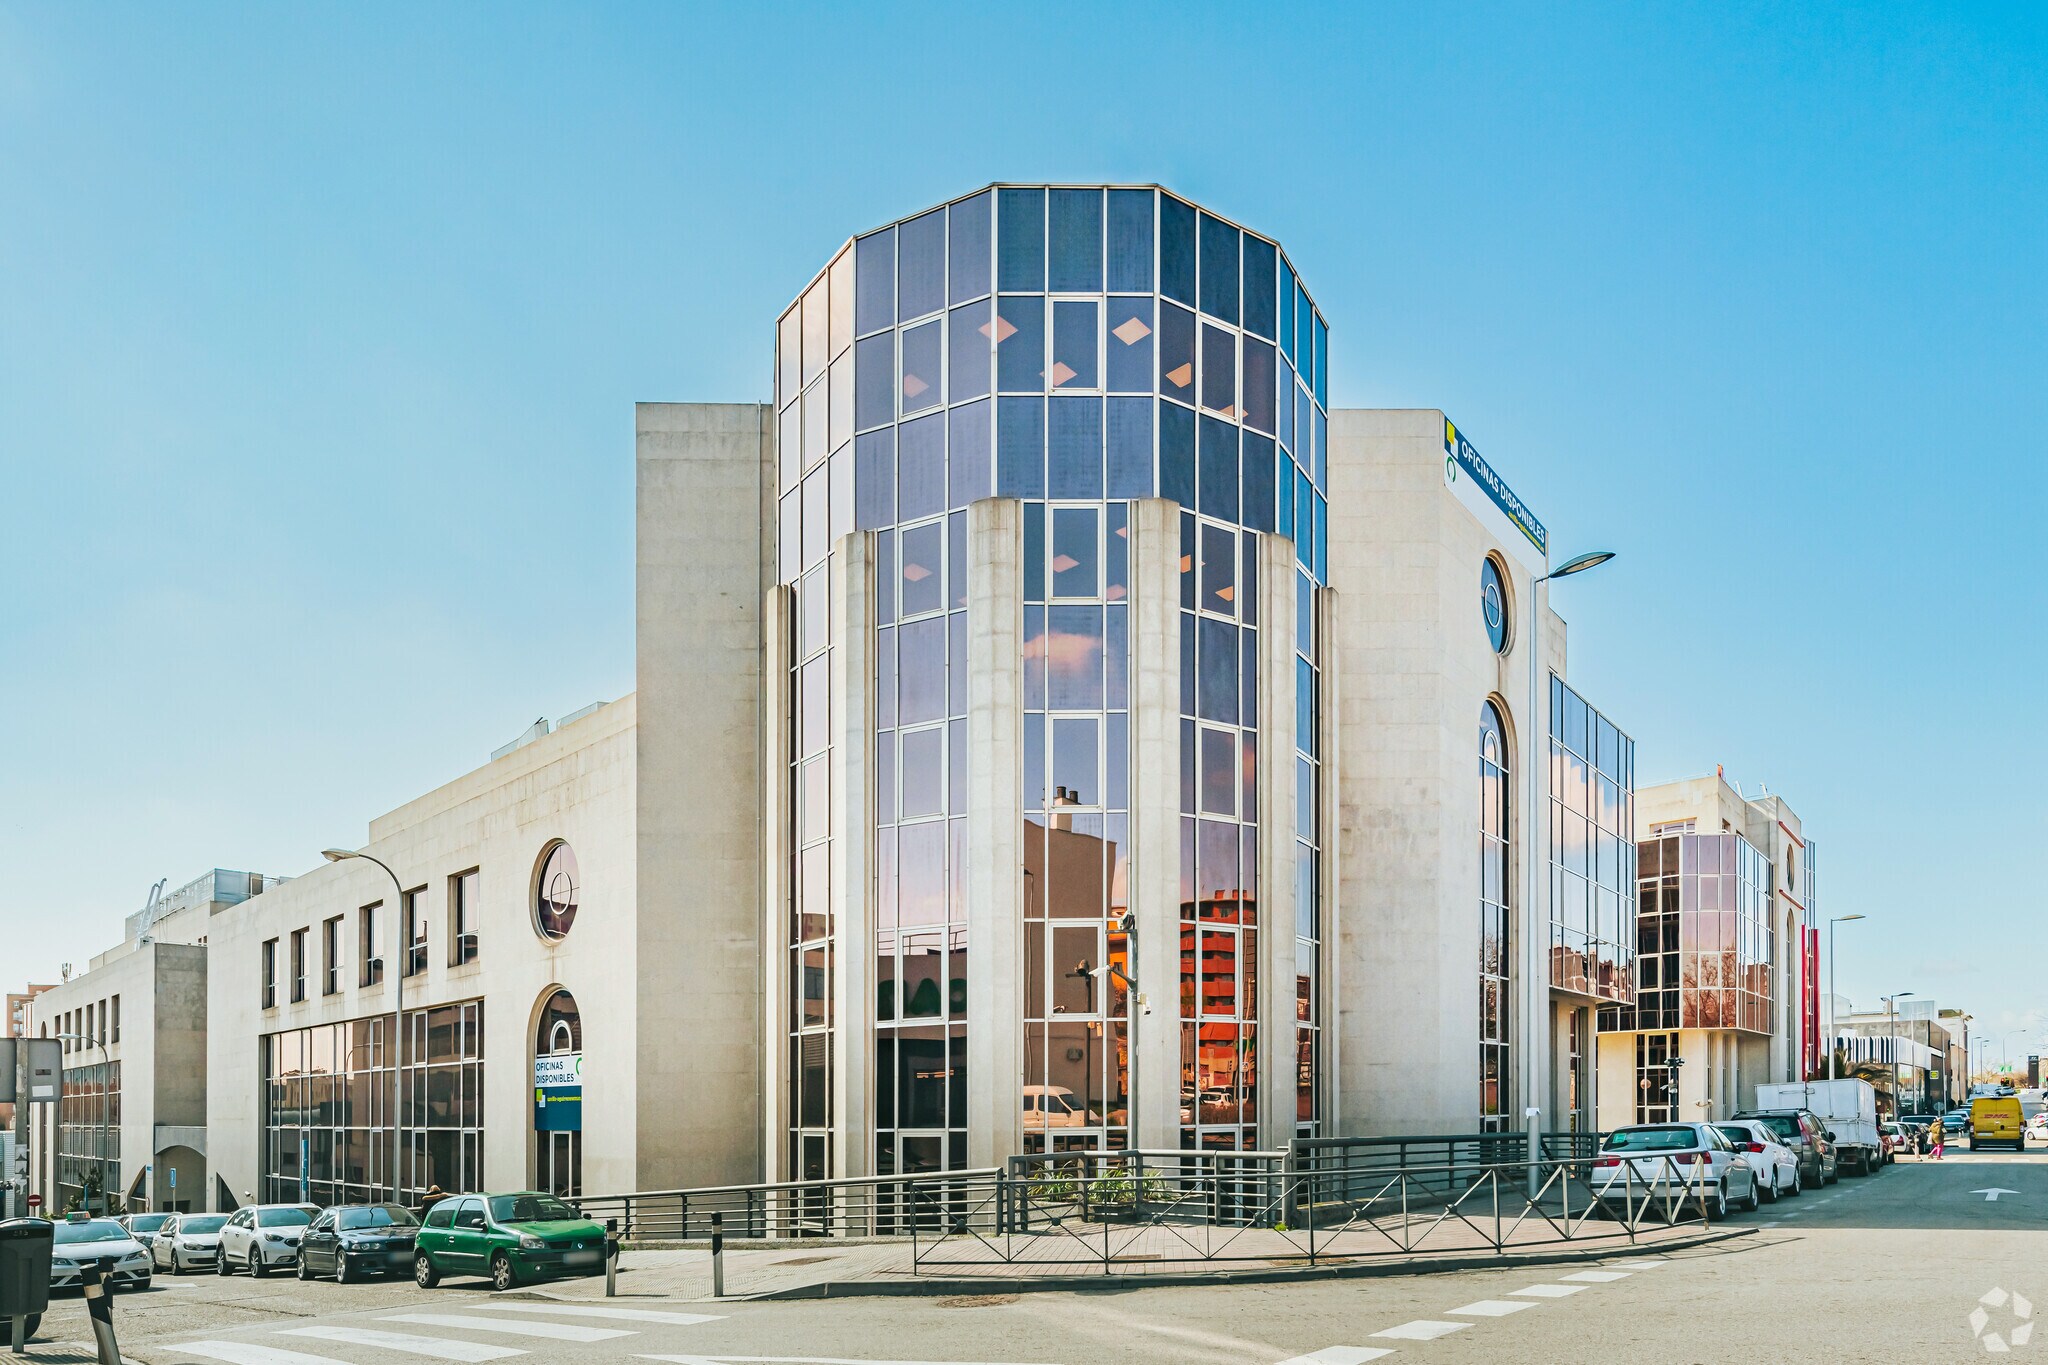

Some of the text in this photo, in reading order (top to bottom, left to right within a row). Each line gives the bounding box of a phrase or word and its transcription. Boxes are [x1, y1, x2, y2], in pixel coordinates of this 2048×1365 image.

[1462, 441, 1499, 493] OFICINAS
[1500, 484, 1545, 543] DISPONIBLES
[536, 1061, 564, 1071] OFICINAS
[536, 1073, 575, 1084] DISPONIBLES
